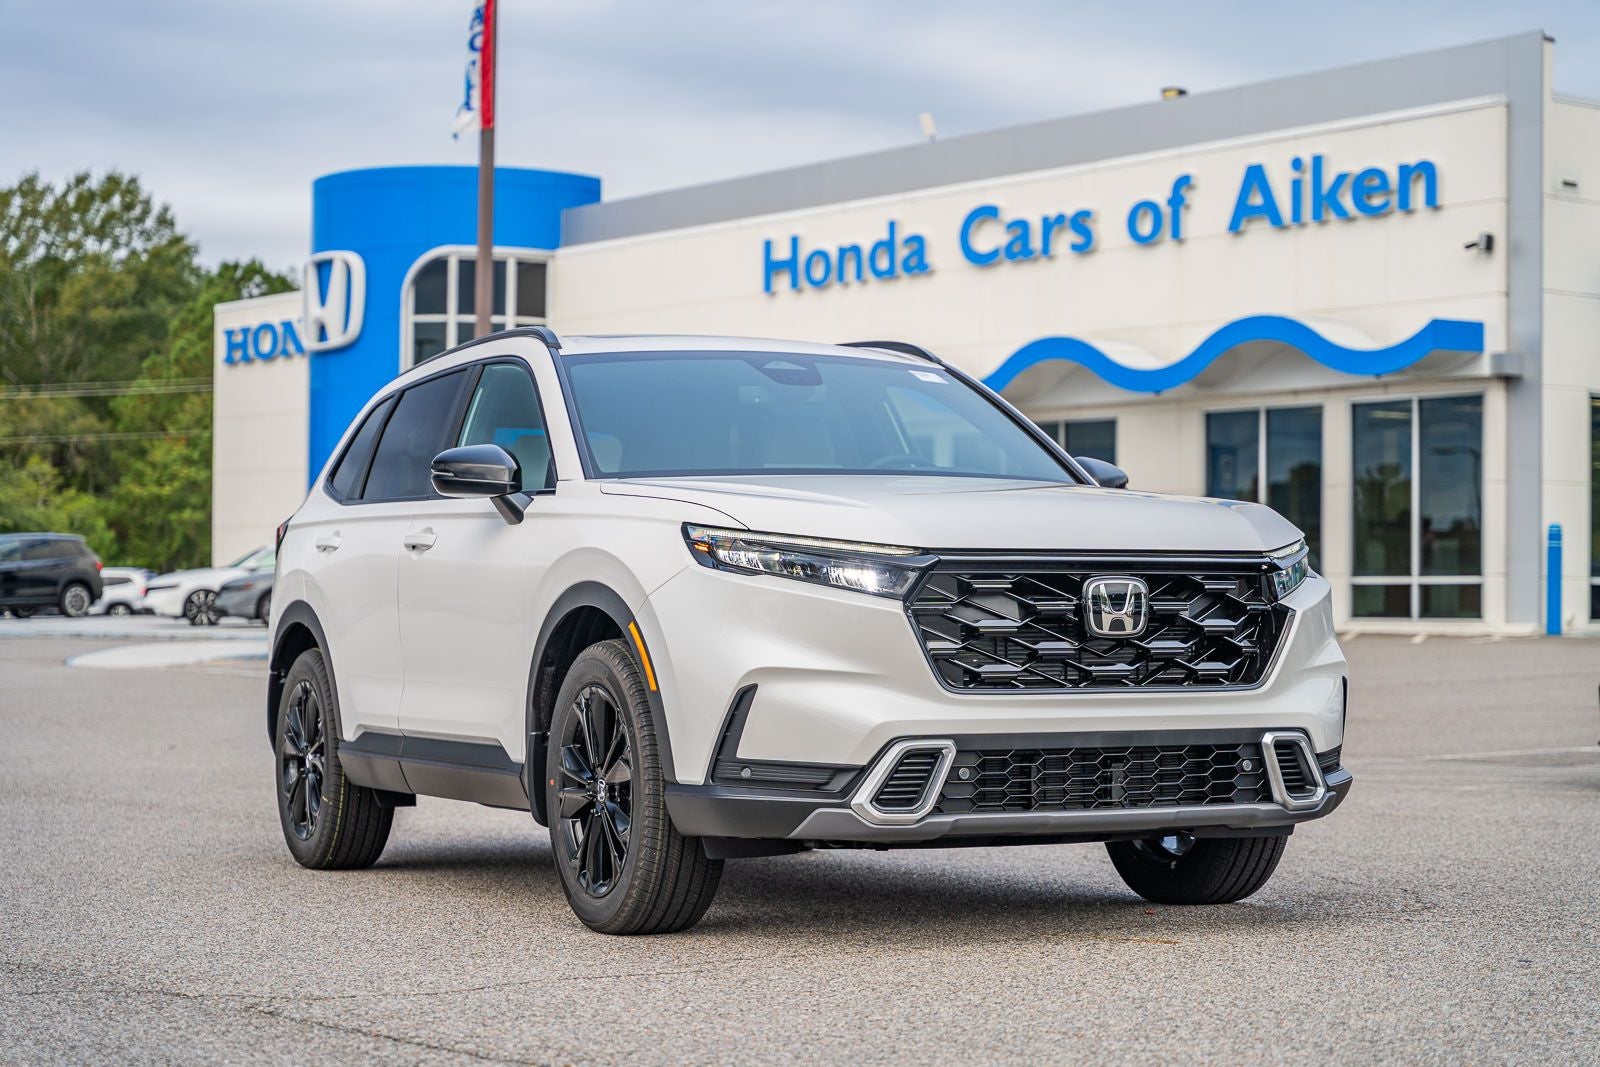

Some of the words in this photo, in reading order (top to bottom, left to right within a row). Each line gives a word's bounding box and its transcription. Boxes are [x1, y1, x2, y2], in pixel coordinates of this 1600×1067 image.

[762, 220, 930, 293] Honda
[959, 204, 1094, 267] Cars
[1126, 174, 1192, 245] of
[1227, 154, 1438, 233] Aiken
